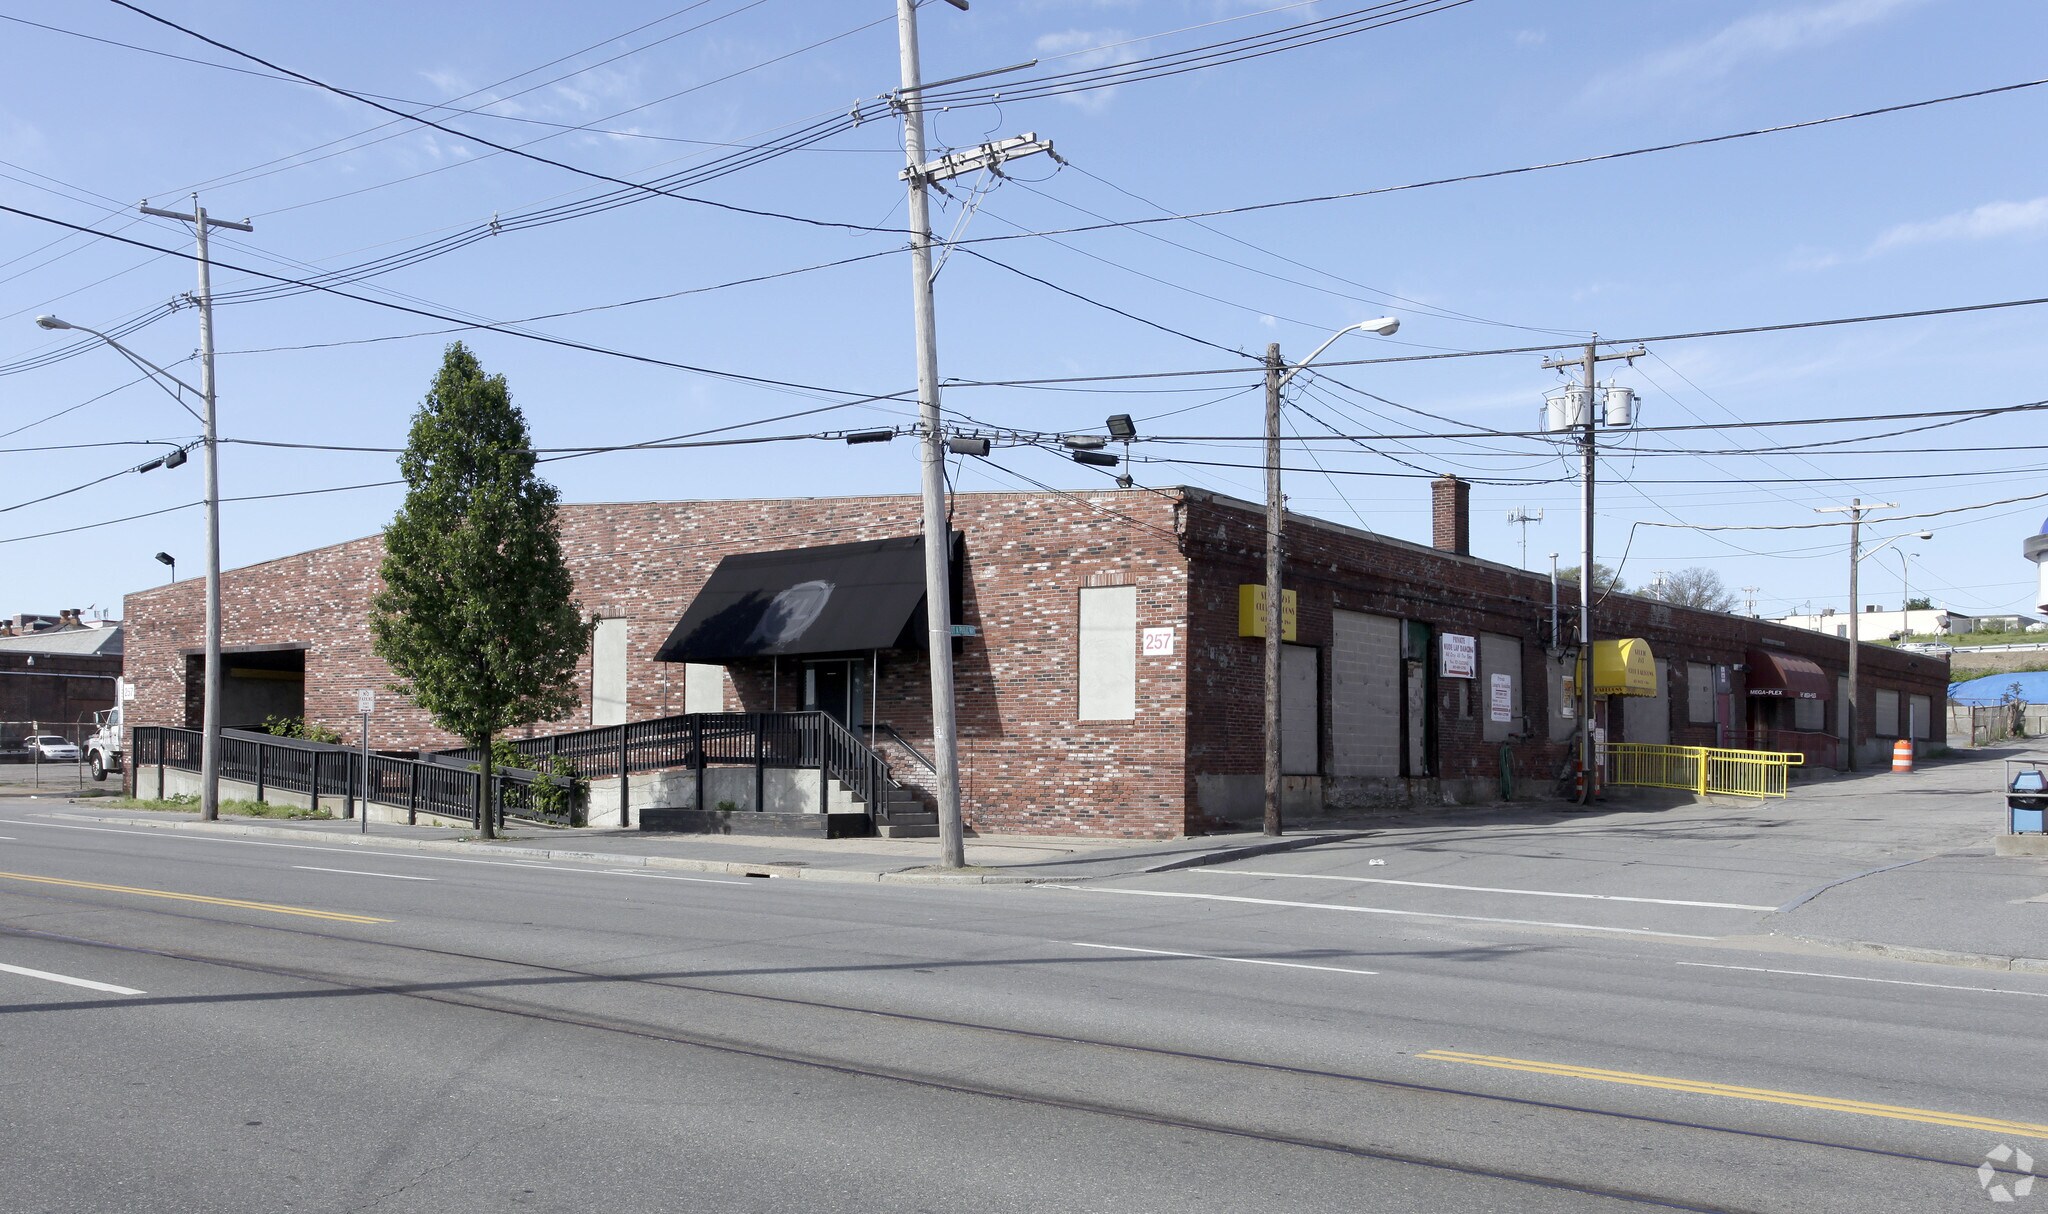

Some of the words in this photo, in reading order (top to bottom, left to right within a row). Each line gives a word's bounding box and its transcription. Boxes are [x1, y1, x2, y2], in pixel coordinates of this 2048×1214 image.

[1146, 633, 1171, 650] 257
[1452, 636, 1465, 644] PRIVATE
[1460, 645, 1473, 653] DANCING
